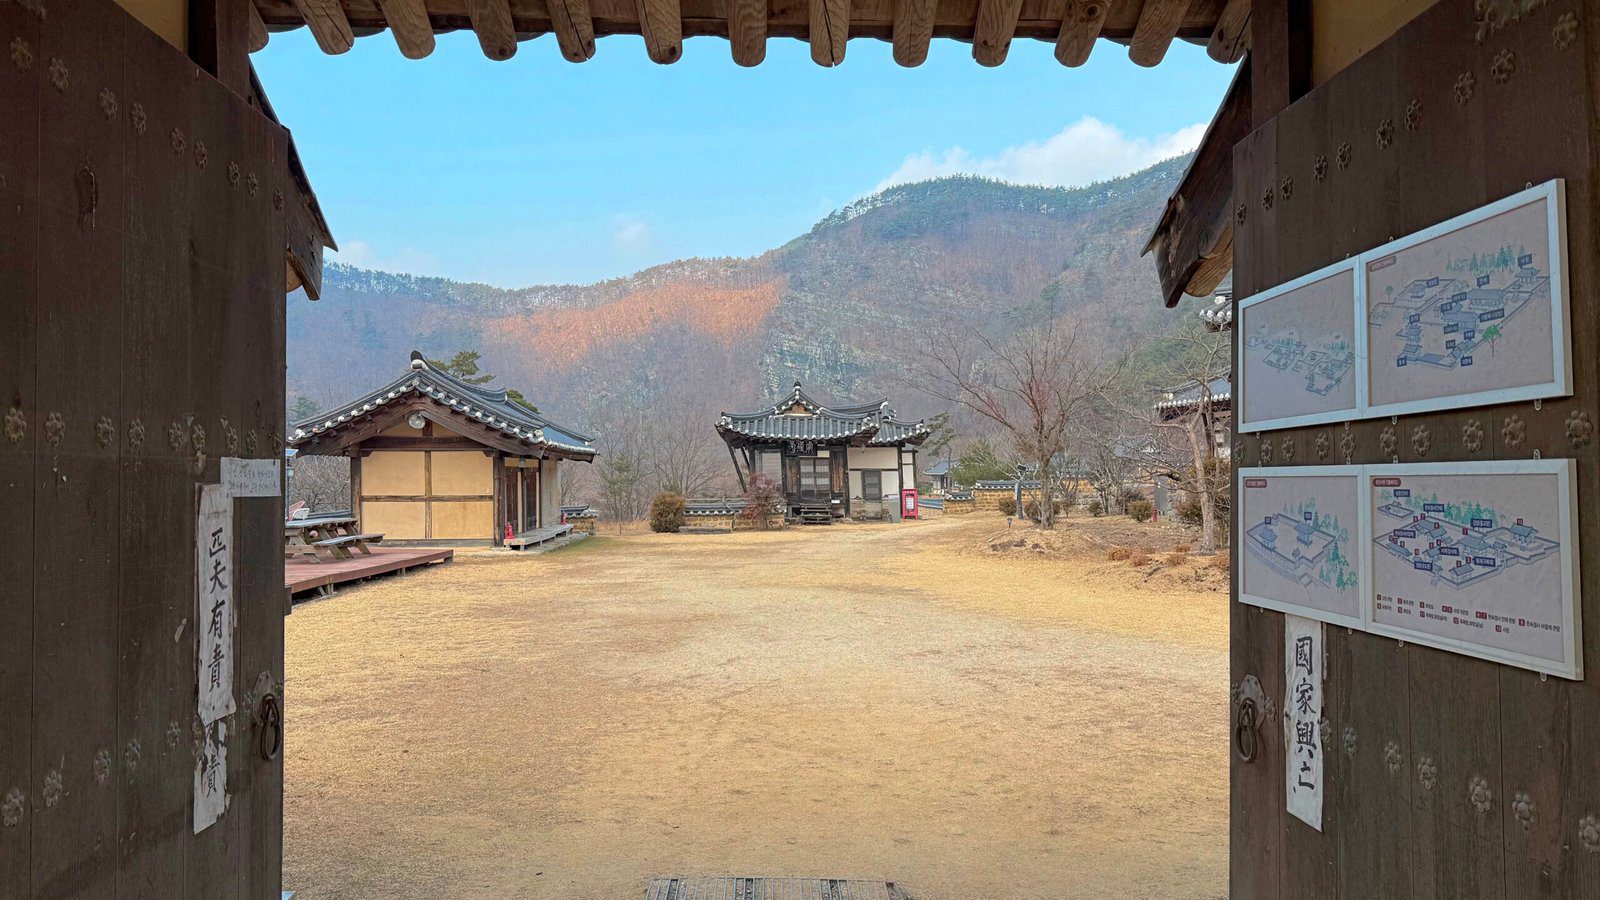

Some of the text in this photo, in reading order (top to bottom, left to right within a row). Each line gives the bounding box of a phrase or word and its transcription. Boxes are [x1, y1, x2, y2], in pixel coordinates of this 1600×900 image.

[207, 528, 228, 693] 匹夫有責
[1295, 635, 1317, 790] 國家興亡
